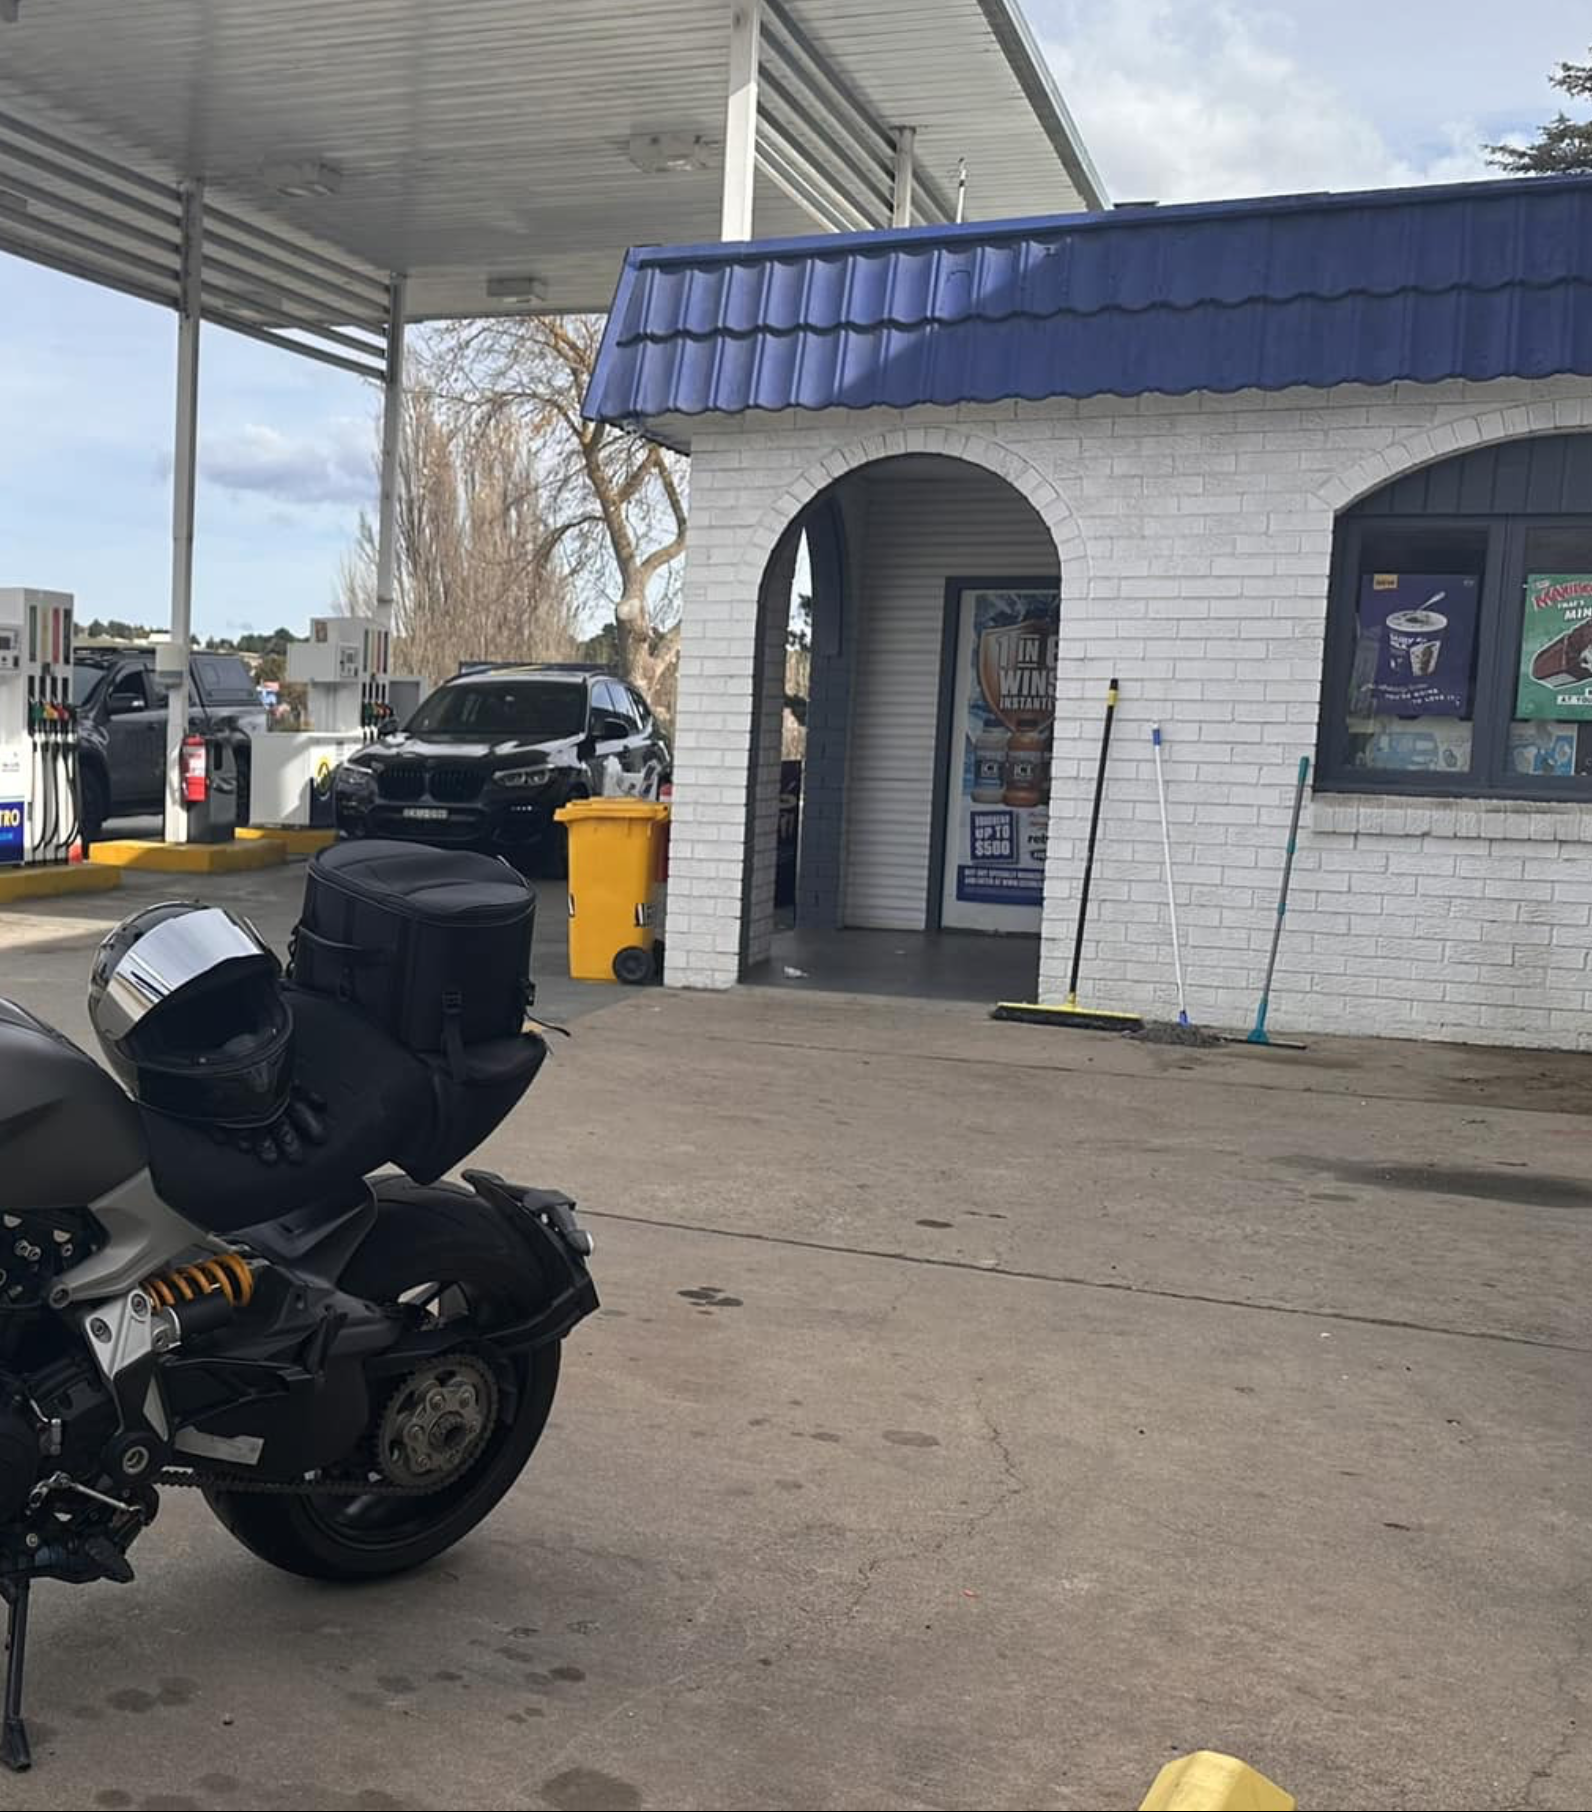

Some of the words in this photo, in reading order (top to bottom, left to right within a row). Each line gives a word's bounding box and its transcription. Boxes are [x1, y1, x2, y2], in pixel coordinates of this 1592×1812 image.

[1564, 607, 1592, 621] MIN
[1019, 639, 1040, 662] IN
[999, 668, 1058, 697] WINS
[999, 697, 1055, 711] INSTANTL
[974, 827, 993, 840] UP
[995, 825, 1010, 840] TO
[974, 839, 1011, 857] $500
